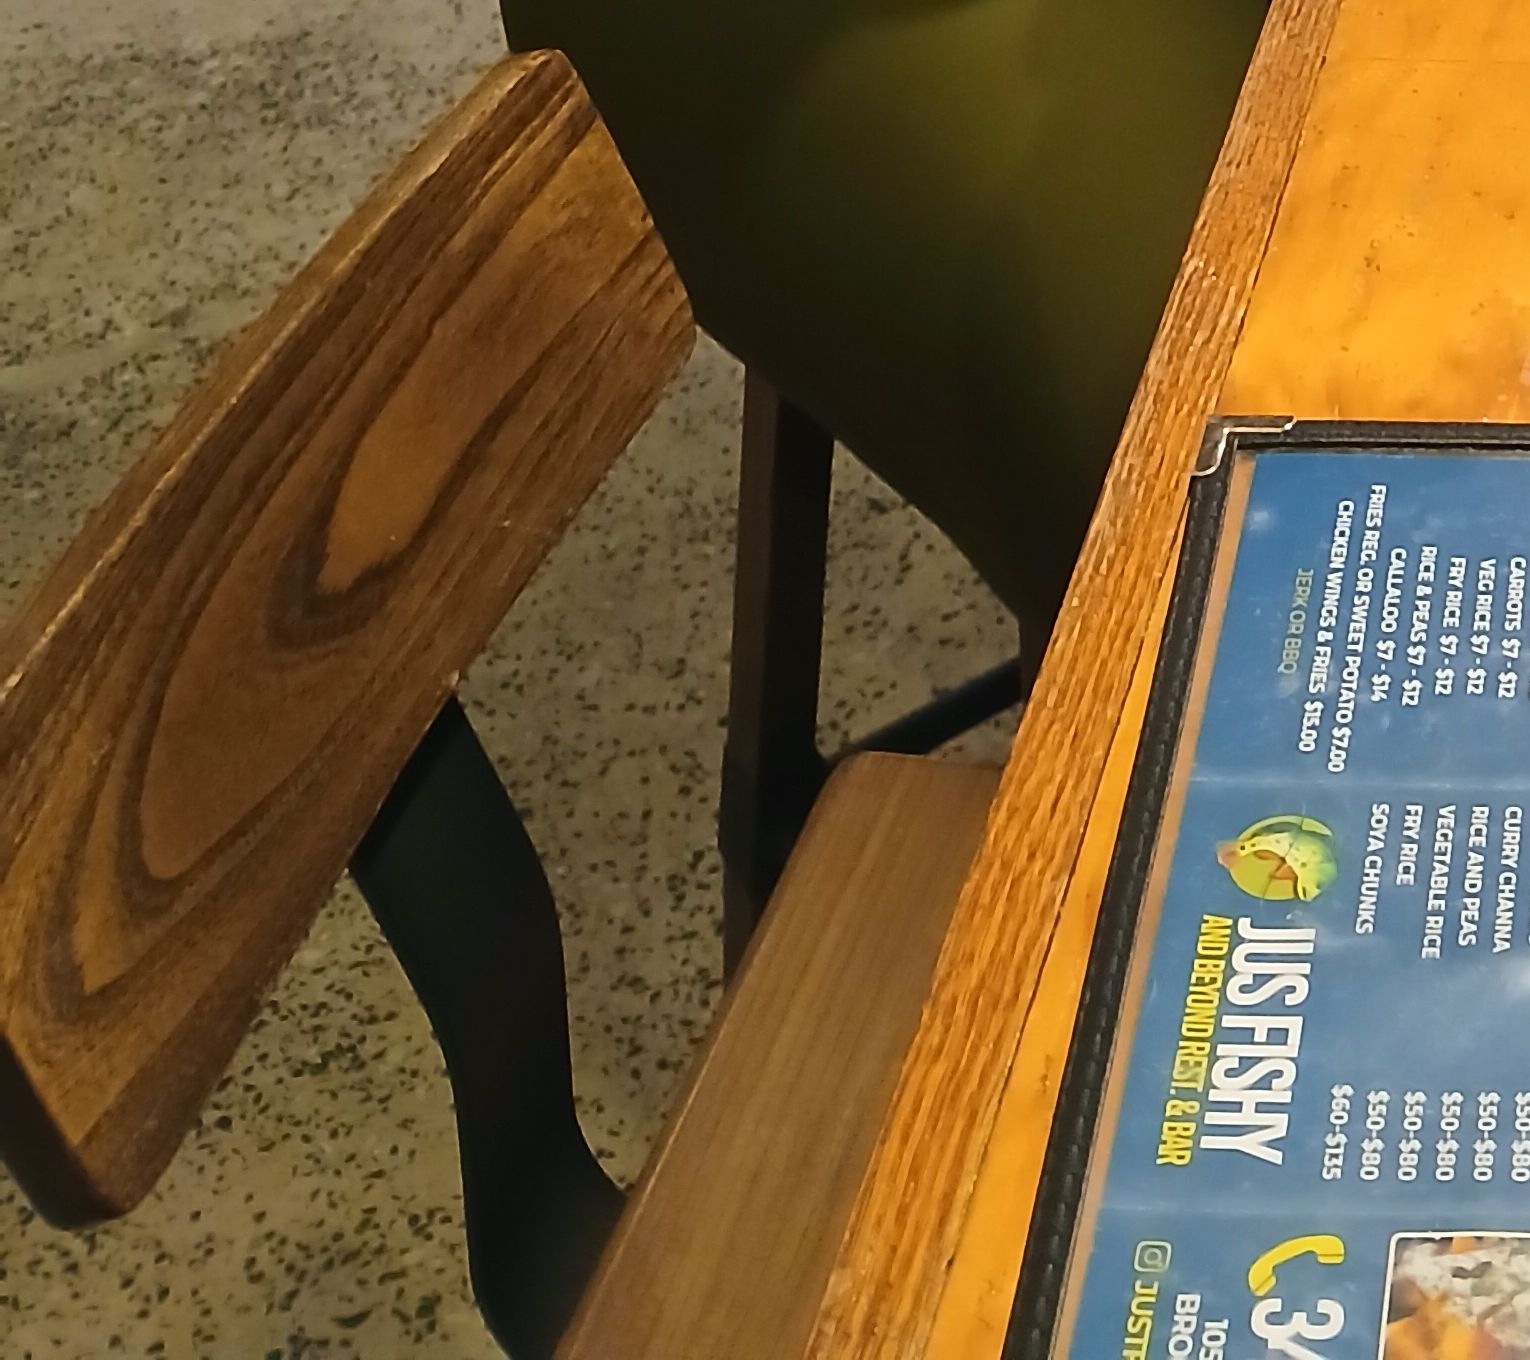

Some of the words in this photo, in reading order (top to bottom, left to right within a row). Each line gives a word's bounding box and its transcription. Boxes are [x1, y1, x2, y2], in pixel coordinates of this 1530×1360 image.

[1365, 485, 1386, 527] FRIES
[1329, 500, 1354, 568] CHICKEN
[1360, 530, 1378, 565] REG.
[1356, 568, 1374, 592] OR
[1417, 546, 1437, 581] RICE
[1448, 558, 1466, 588] FRY
[1478, 559, 1496, 592] VEG
[1319, 572, 1343, 627] WINGS
[1380, 548, 1407, 632] CALLALOO
[1416, 586, 1432, 596] &
[1442, 591, 1462, 628] RICE
[1504, 557, 1526, 631] CARROTS
[1346, 595, 1370, 652] SWEET
[1410, 600, 1430, 642] PEAS
[1474, 594, 1492, 631] RICE
[1317, 630, 1334, 642] &
[1376, 640, 1396, 660] $7
[1406, 646, 1426, 665] $7
[1439, 635, 1458, 654] $7
[1470, 634, 1490, 654] $7
[1502, 638, 1521, 658] $7
[1308, 646, 1332, 693] FRIES
[1336, 656, 1362, 723] POTATO
[1370, 674, 1391, 702] $14
[1435, 668, 1455, 695] $12
[1466, 668, 1486, 694] $12
[1498, 672, 1518, 698] $12
[1402, 680, 1422, 706] $12
[1298, 700, 1324, 752] $15.00
[1327, 727, 1352, 772] $7.00
[1367, 804, 1390, 852] SOYA
[1402, 804, 1423, 840] FRY
[1468, 806, 1488, 848] RICE
[1501, 806, 1522, 868] CURRY
[1396, 843, 1418, 886] RICE
[1427, 806, 1456, 911] VEGETABLE
[1464, 852, 1485, 893] AND
[1355, 856, 1382, 934] CHUNKS
[1492, 872, 1516, 953] CHANNA
[1198, 915, 1233, 956] AND
[1421, 916, 1444, 959] RICE
[1458, 898, 1480, 946] PEAS
[1226, 917, 1316, 1006] JUS
[1180, 959, 1222, 1042] BEYOND
[1170, 1041, 1212, 1095] REST.
[1165, 1100, 1200, 1117] &
[1199, 1016, 1304, 1166] FISHY
[1156, 1121, 1195, 1166] BAR
[1322, 1084, 1354, 1179] $60-$135
[1360, 1090, 1390, 1180] $50-$80
[1398, 1091, 1427, 1181] $50-$80
[1436, 1092, 1463, 1181] $50-$80
[1473, 1092, 1501, 1181] $50-$80
